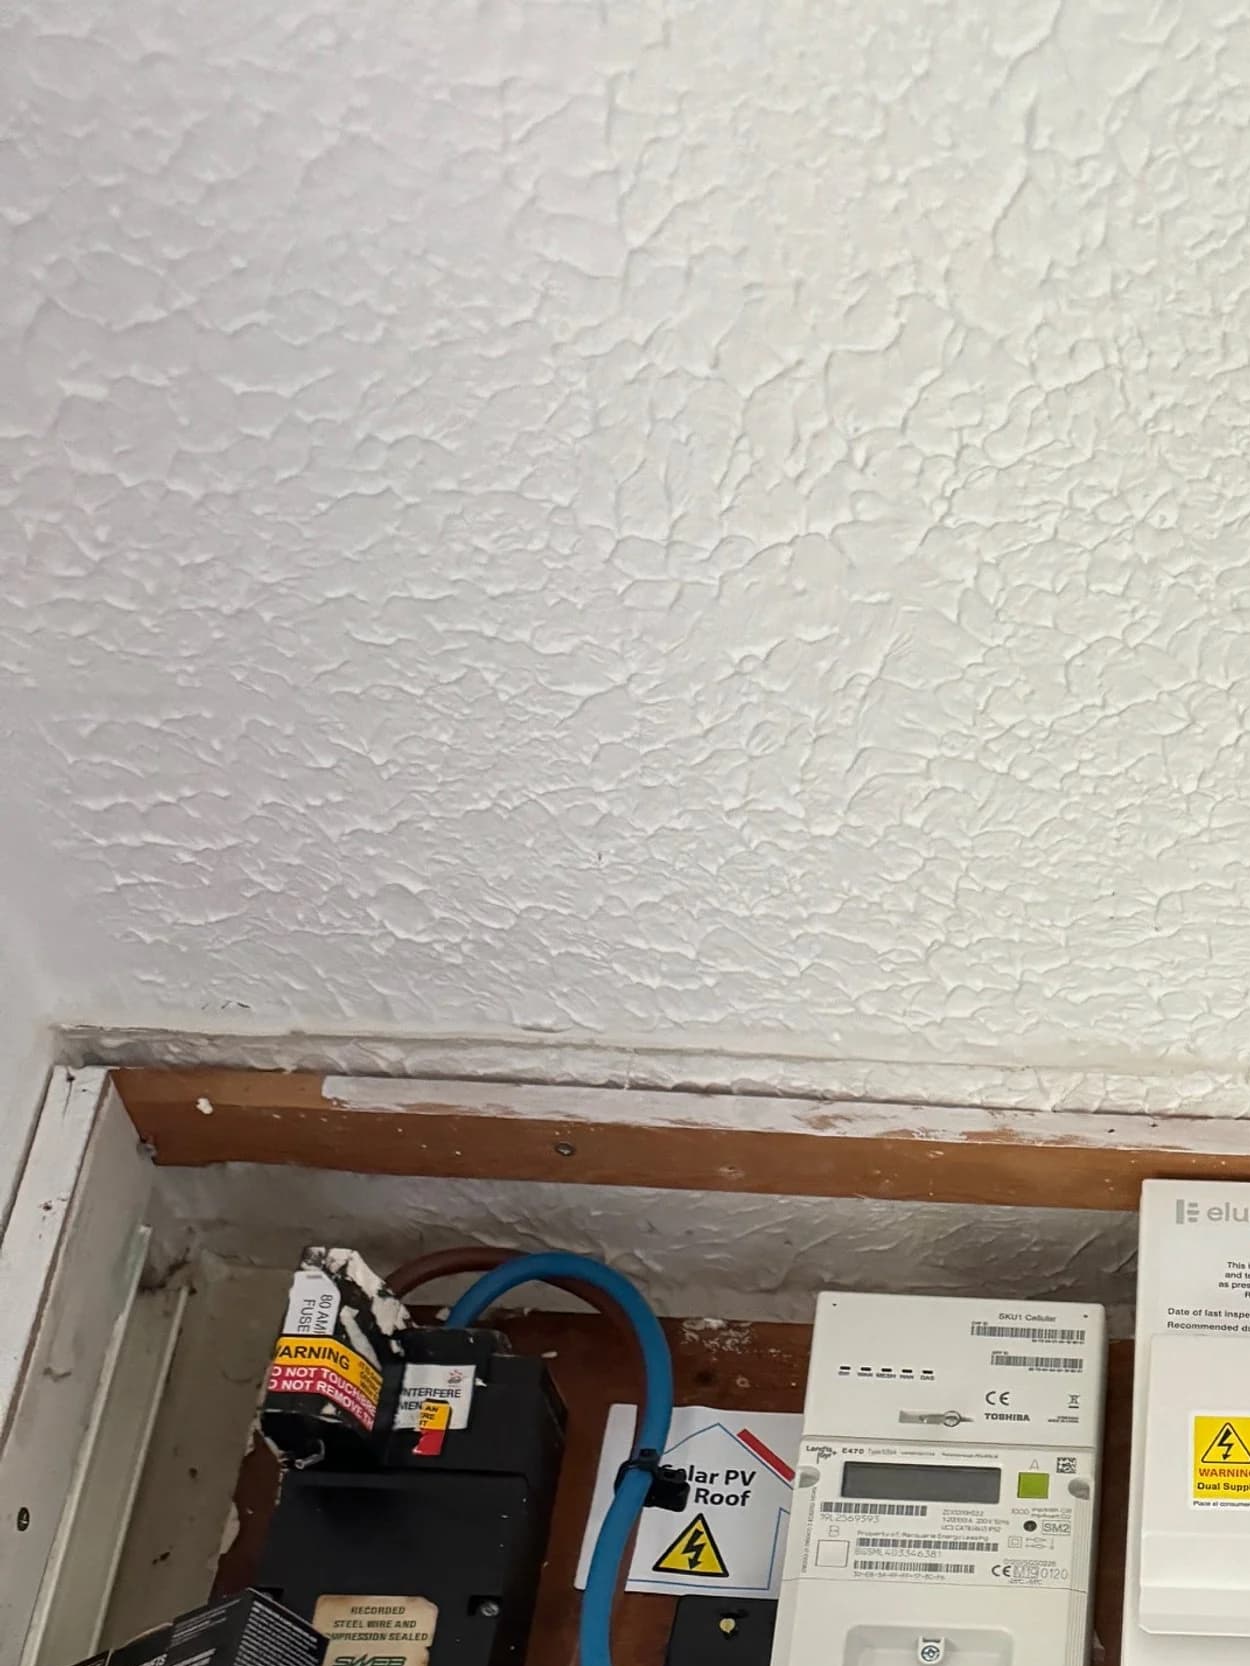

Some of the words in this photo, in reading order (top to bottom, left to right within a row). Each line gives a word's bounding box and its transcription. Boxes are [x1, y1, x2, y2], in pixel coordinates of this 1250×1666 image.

[297, 1299, 316, 1333] FUSE
[1168, 1308, 1190, 1316] Date
[1205, 1309, 1222, 1317] last
[1167, 1321, 1238, 1332] Recommended
[278, 1345, 350, 1371] ARNING
[286, 1368, 318, 1378] NOT
[281, 1380, 314, 1391] NOT
[984, 1412, 1030, 1422] TOSHIBA
[725, 1470, 756, 1486] PV
[1197, 1482, 1220, 1491] Dual
[694, 1488, 752, 1506] Roof
[351, 1606, 406, 1615] RECORDED
[333, 1620, 363, 1628] STEEL
[367, 1620, 392, 1628] WIRE
